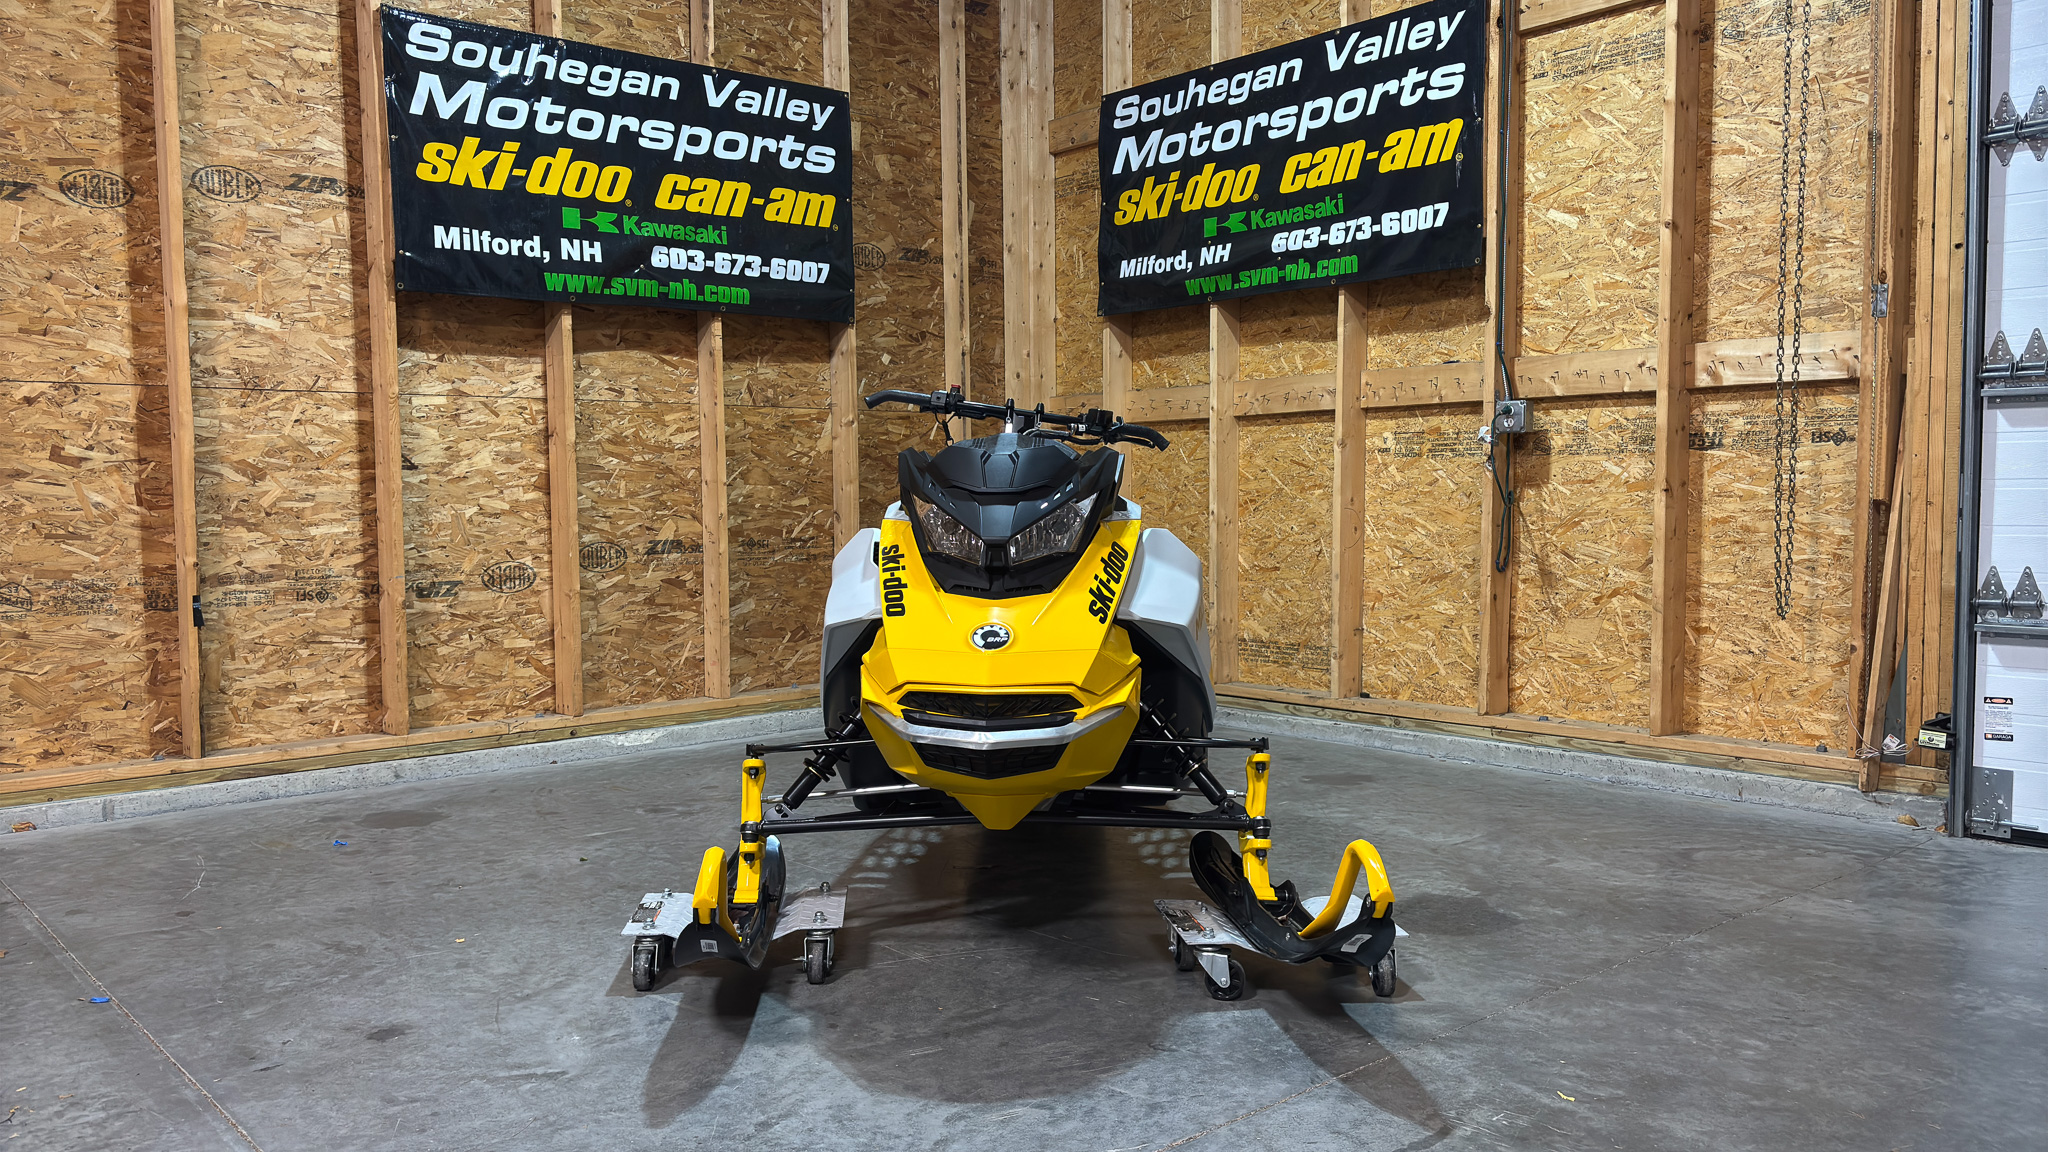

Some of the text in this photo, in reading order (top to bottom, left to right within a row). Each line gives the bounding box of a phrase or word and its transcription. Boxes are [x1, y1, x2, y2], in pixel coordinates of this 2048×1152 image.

[405, 22, 836, 131] Souhegan Valley
[1113, 10, 1466, 129] Souhegan Valley
[409, 71, 837, 174] Motorsports
[1112, 63, 1466, 175] Motorsports
[416, 136, 836, 228] ski-doo can-am
[1114, 118, 1464, 226] ski-doo can-am
[623, 215, 728, 245] Kawasaki
[1251, 193, 1344, 231] Kawasaki
[1271, 202, 1450, 254] 603-673-6007
[433, 225, 603, 263] Milford, NH
[650, 245, 830, 284] 603-673-6007
[1119, 243, 1232, 279] Milford, NH
[544, 272, 751, 306] www.svm-nh.com
[1185, 253, 1358, 297] www.svm-nh.com
[882, 543, 909, 617] ski-doo
[1088, 541, 1129, 624] ski-doo
[986, 635, 1009, 644] BRP
